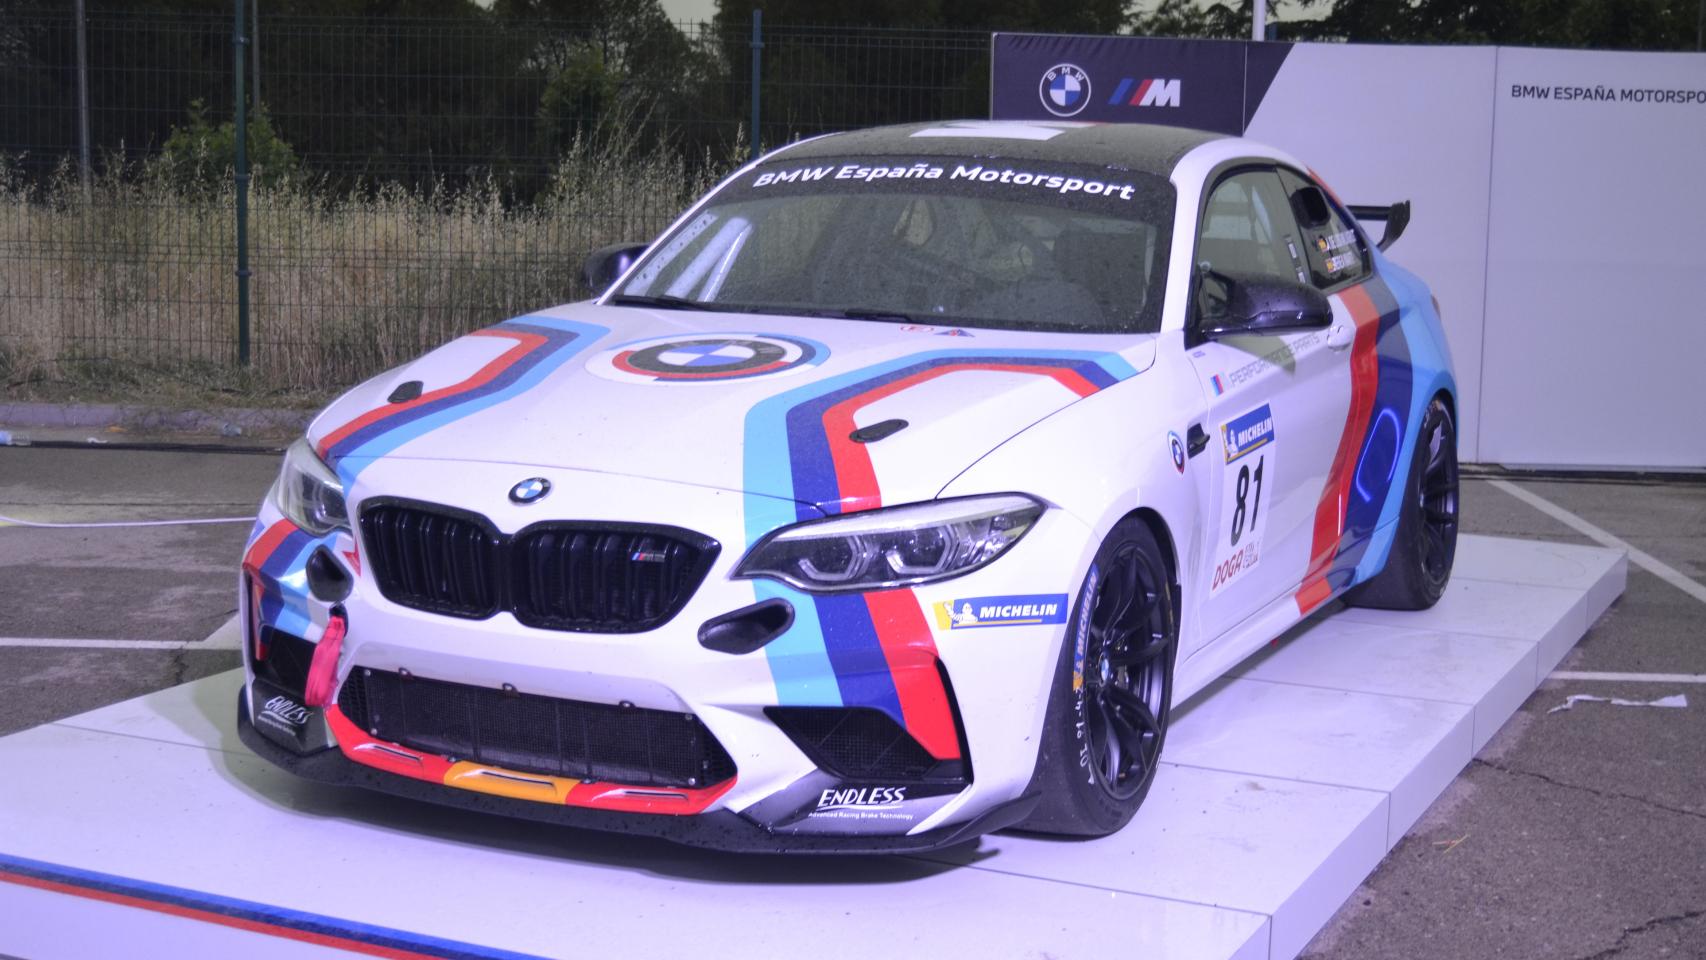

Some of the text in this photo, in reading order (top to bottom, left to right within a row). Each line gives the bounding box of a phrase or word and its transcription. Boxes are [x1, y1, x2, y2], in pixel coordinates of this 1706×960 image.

[1047, 66, 1085, 82] BMW
[1511, 84, 1550, 99] BMW
[1554, 85, 1616, 102] ESPAÑA
[752, 163, 1136, 200] BMW España Motorsport
[1238, 416, 1274, 447] MICHELIN
[1230, 454, 1264, 547] 81
[1212, 548, 1244, 591] DOGA
[979, 603, 1058, 618] MICHELIN
[817, 786, 907, 808] ENDLESS
